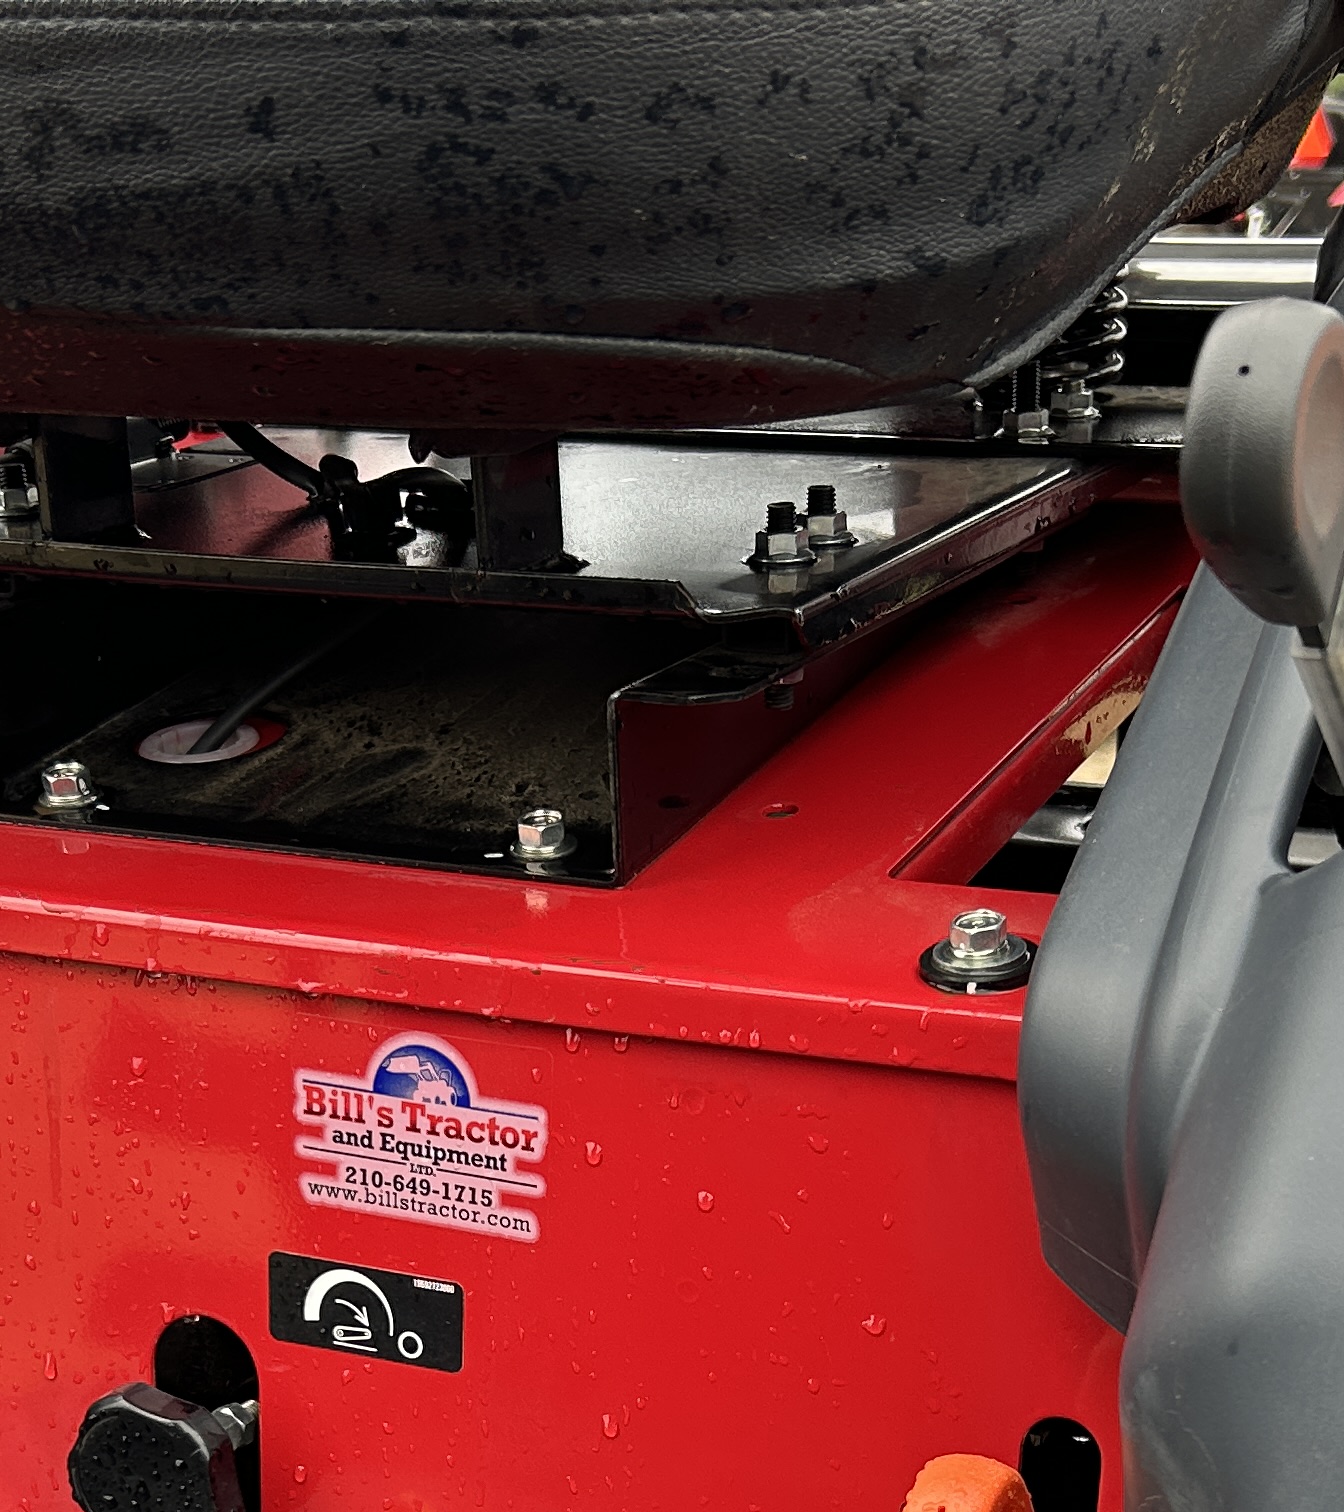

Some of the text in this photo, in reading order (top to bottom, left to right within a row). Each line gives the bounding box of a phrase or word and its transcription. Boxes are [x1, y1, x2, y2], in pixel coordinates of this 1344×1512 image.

[302, 1084, 539, 1153] Bill's Tractor
[332, 1129, 508, 1173] and Equipment
[409, 1162, 437, 1178] LTD.
[307, 1182, 532, 1233] www.billstractor.com
[345, 1166, 493, 1208] 210-649-1715
